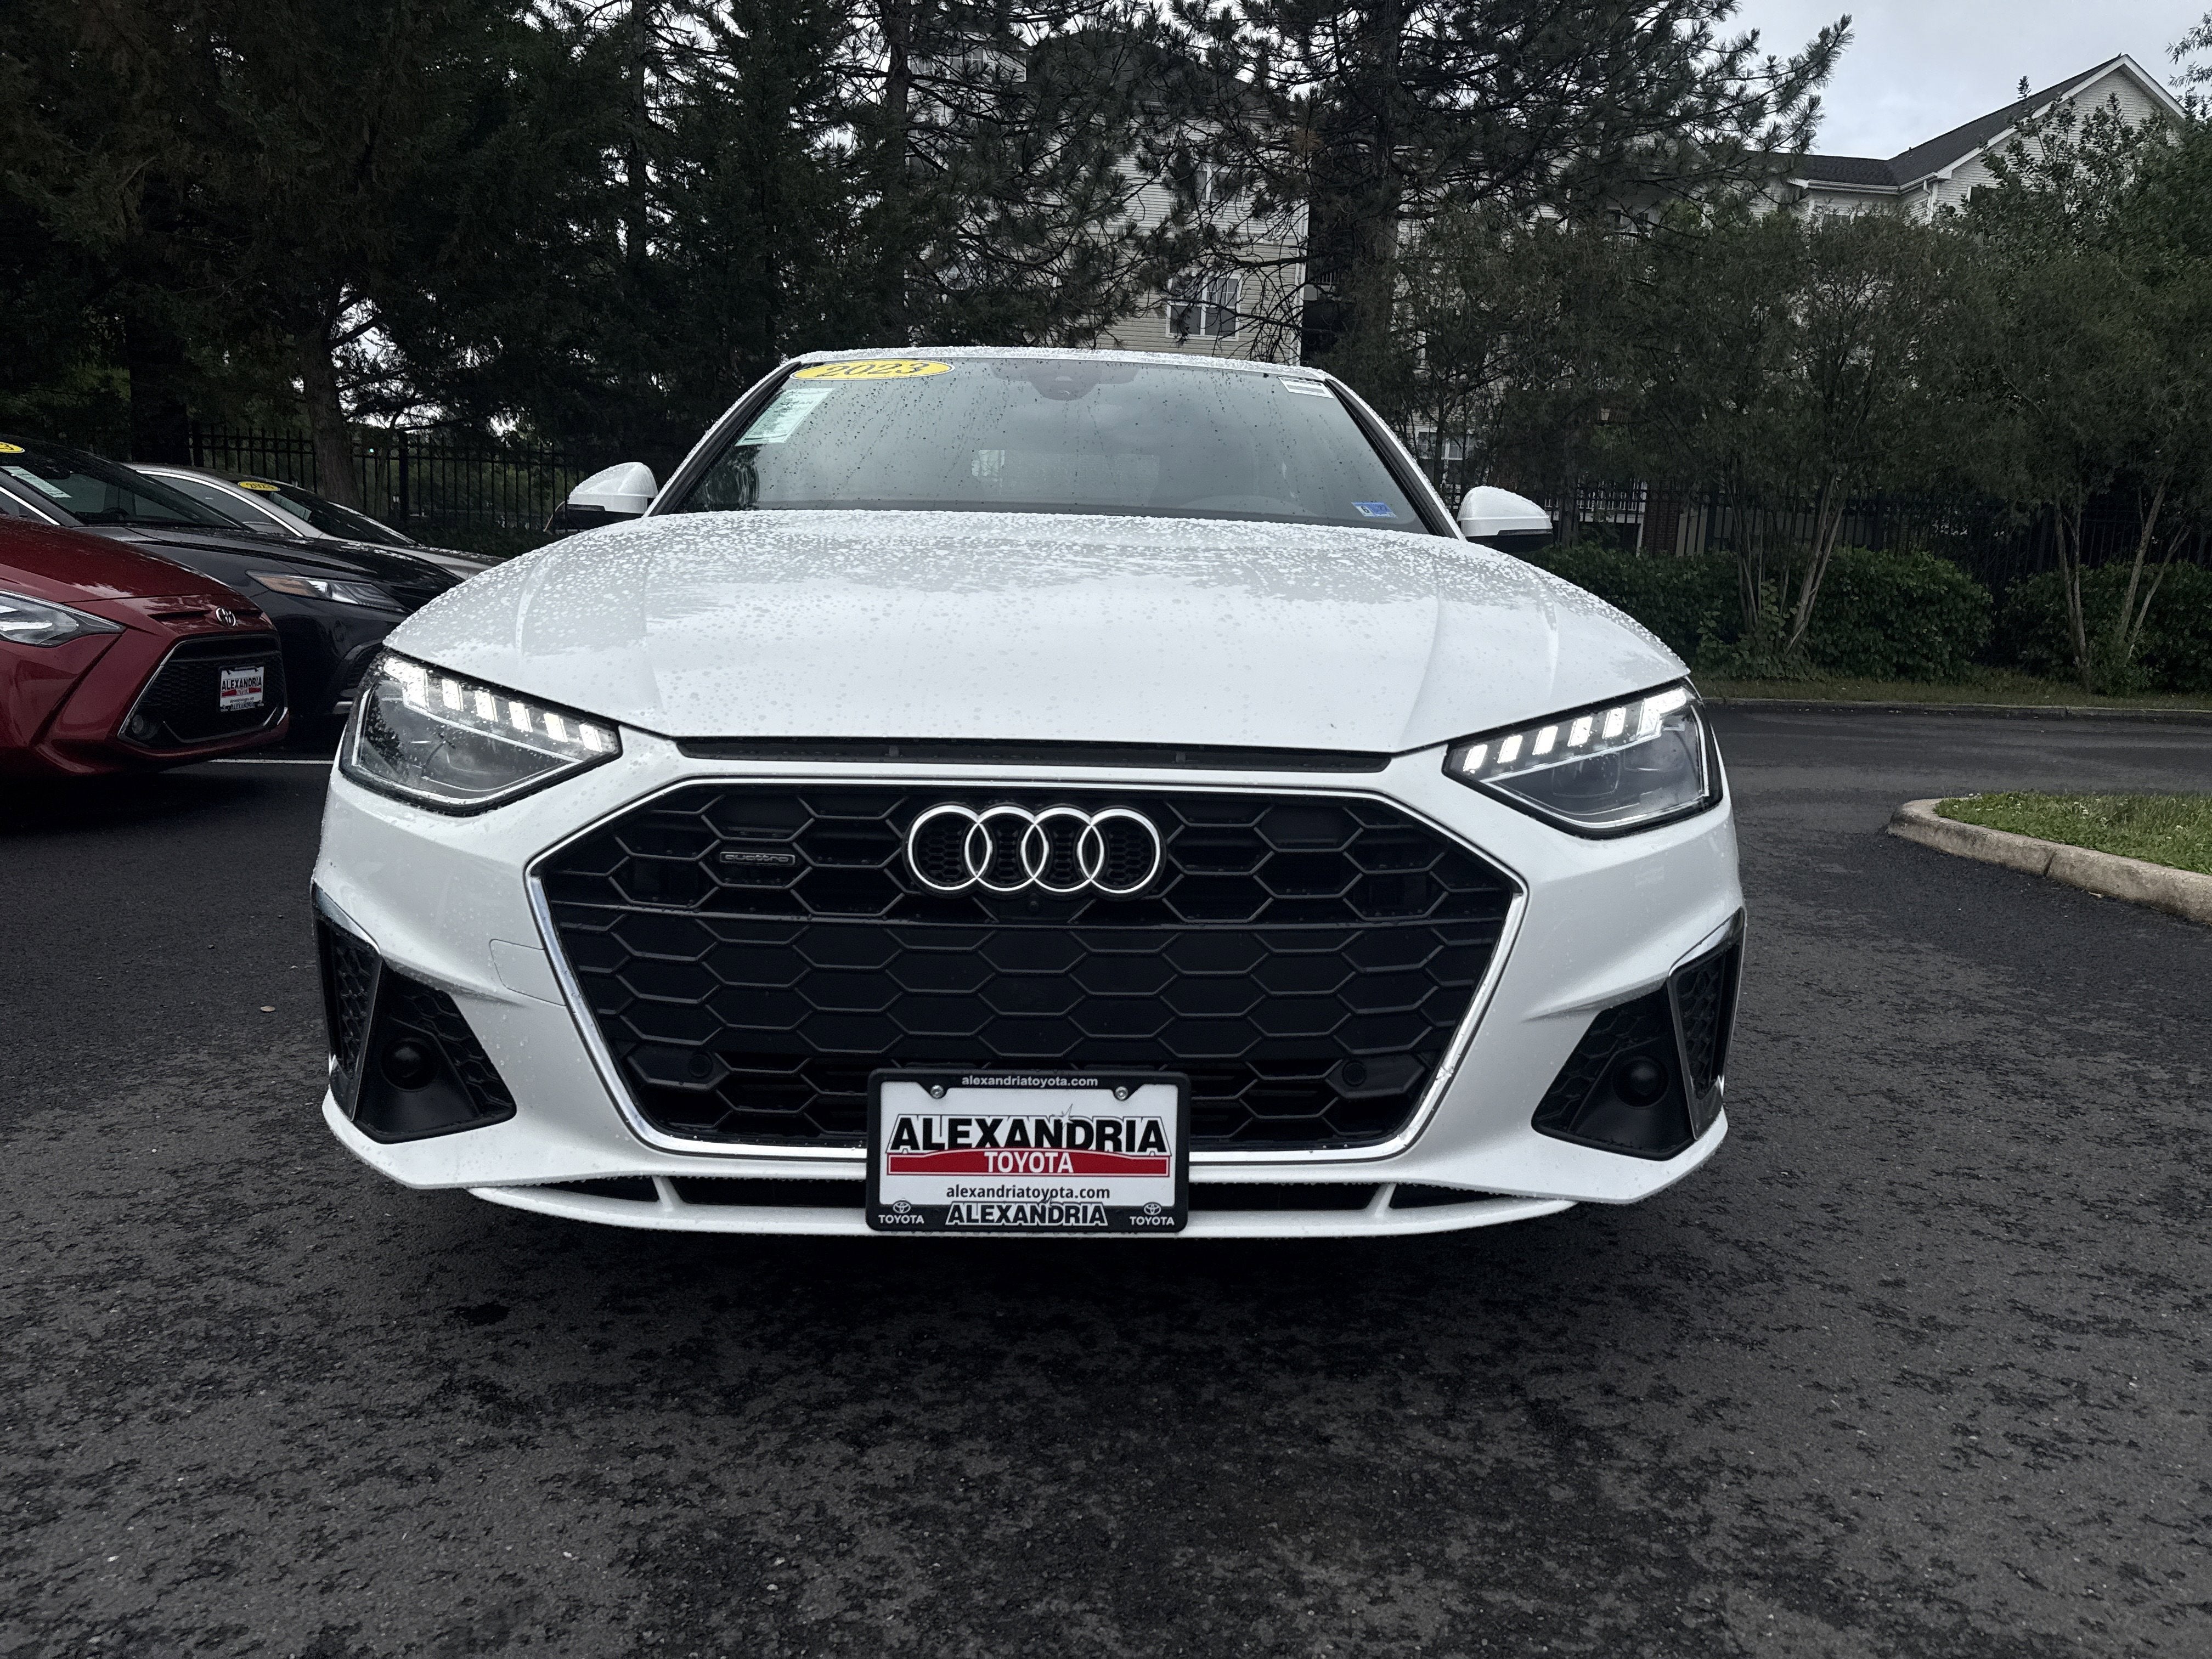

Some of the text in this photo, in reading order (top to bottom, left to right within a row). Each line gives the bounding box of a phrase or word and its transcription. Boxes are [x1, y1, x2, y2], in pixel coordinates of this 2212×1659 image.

[814, 363, 930, 377] 2023
[222, 676, 262, 691] ALEXANDRIA
[962, 1075, 1098, 1088] alexandriatoyota.com
[890, 1117, 1169, 1153] ALEXANDRIA
[984, 1152, 1074, 1173] TOYOTA
[946, 1184, 1110, 1200] alexandriatoyota.com
[878, 1214, 925, 1225] TOYOTA
[945, 1202, 1108, 1226] ALEXANDRIA
[1130, 1216, 1175, 1226] TOYOTA
